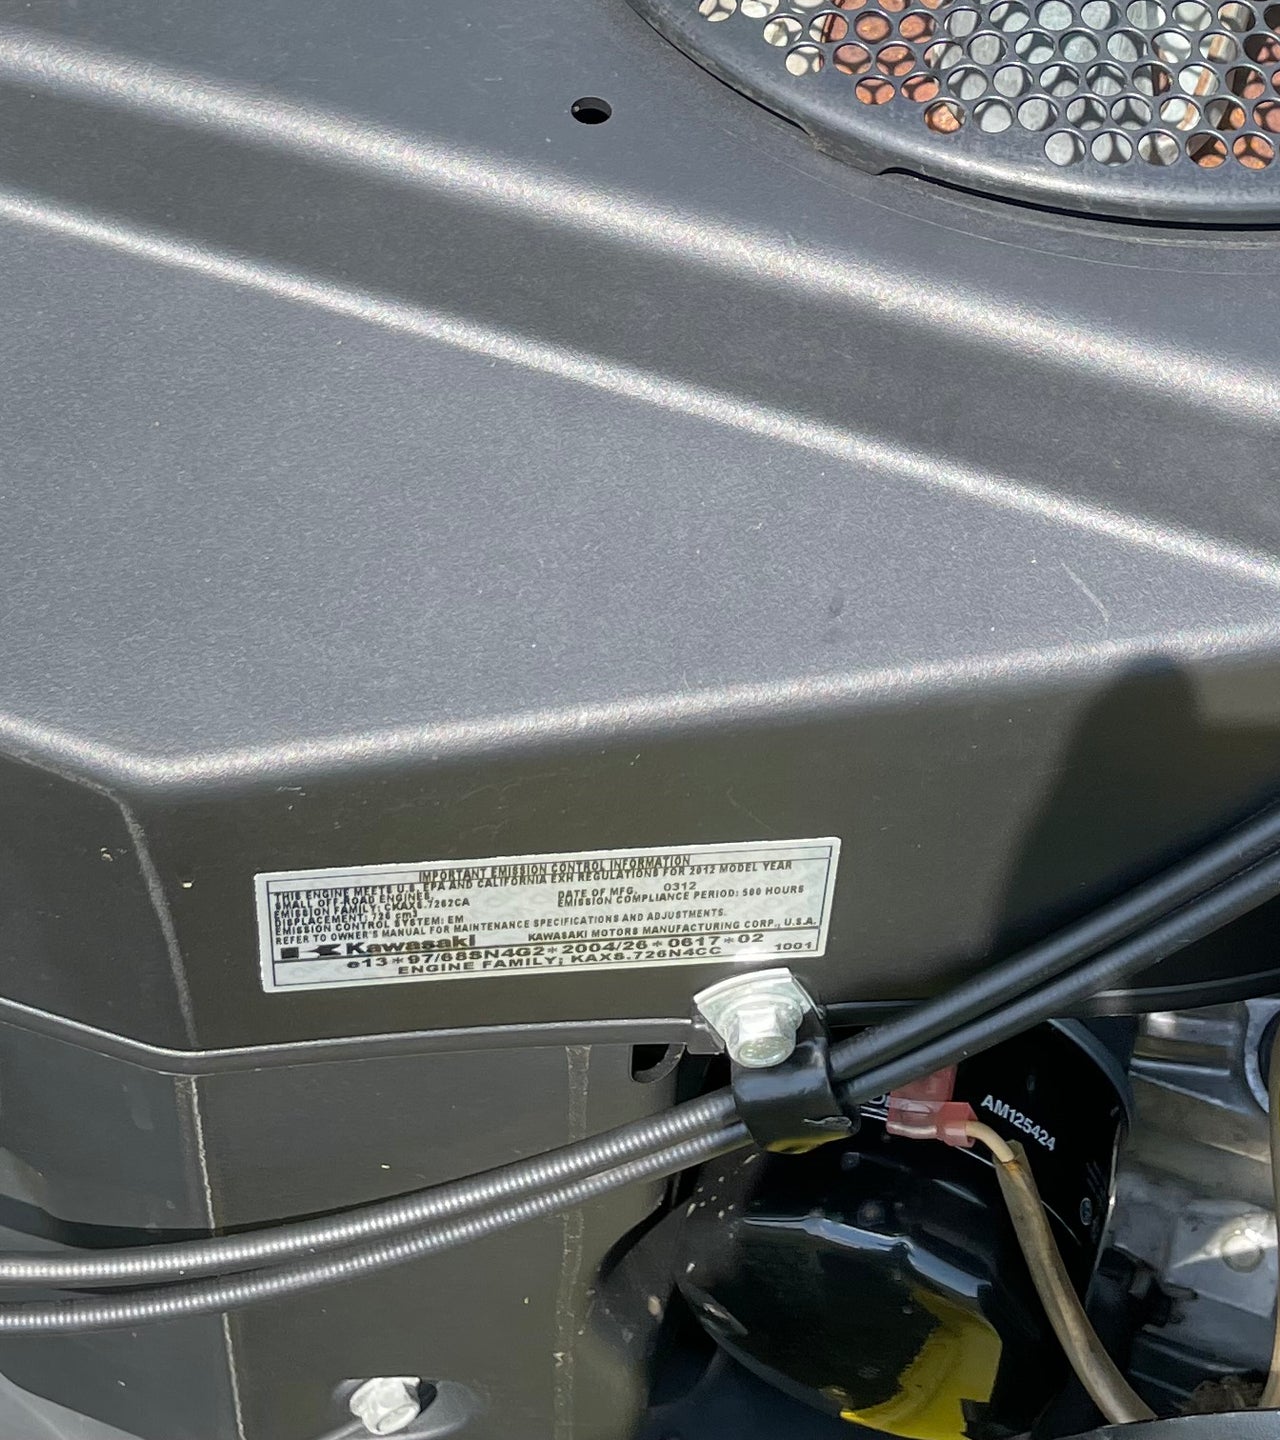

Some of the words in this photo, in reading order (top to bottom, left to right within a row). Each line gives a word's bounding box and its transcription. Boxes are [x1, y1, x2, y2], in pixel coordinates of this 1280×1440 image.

[419, 868, 486, 882] IMPORTANT
[492, 864, 547, 877] EMISSION
[551, 860, 604, 873] CONTROL
[610, 855, 690, 869] INFORMATION
[274, 891, 301, 901] THIS
[305, 888, 349, 898] ENGINE
[354, 885, 391, 895] MEETS
[423, 881, 444, 891] EPA
[448, 879, 472, 889] AND
[477, 874, 547, 887] CALIFORNIA
[550, 873, 573, 883] EXH
[578, 868, 658, 881] REGULATIONS
[662, 866, 684, 876] FOR
[689, 865, 715, 874] 2012
[719, 862, 757, 873] MODEL
[762, 860, 792, 870] YEAR
[558, 889, 586, 899] DATE
[592, 888, 604, 896] OF
[663, 881, 696, 891] 0312
[275, 899, 312, 909] SMALL
[317, 895, 374, 906] OFF-ROAD
[557, 896, 611, 907] EMISSION
[616, 892, 689, 903] COMPLIANCE
[742, 887, 761, 896] 500
[765, 885, 804, 894] HOURS
[274, 907, 329, 918] EMISSION
[372, 912, 390, 920] 726
[275, 924, 330, 935] EMISSION
[335, 920, 389, 930] CONTROL
[448, 915, 463, 923] EM
[275, 935, 308, 944] REFER
[313, 933, 326, 941] TO
[330, 930, 378, 940] OWNER'S
[382, 927, 425, 936] MANUAL
[430, 925, 449, 933] FOR
[453, 920, 529, 932] MAINTENANCE
[533, 914, 618, 927] SPECIFICATIONS
[622, 913, 643, 921] AND
[527, 930, 587, 941] KAWASAKI
[591, 927, 637, 937] MOTORS
[642, 921, 739, 934] MANUFACTURING
[346, 934, 474, 954] Kawasaki
[774, 941, 811, 950] 1001
[398, 961, 474, 974] ENGINE
[980, 1093, 1057, 1152] AM125424
